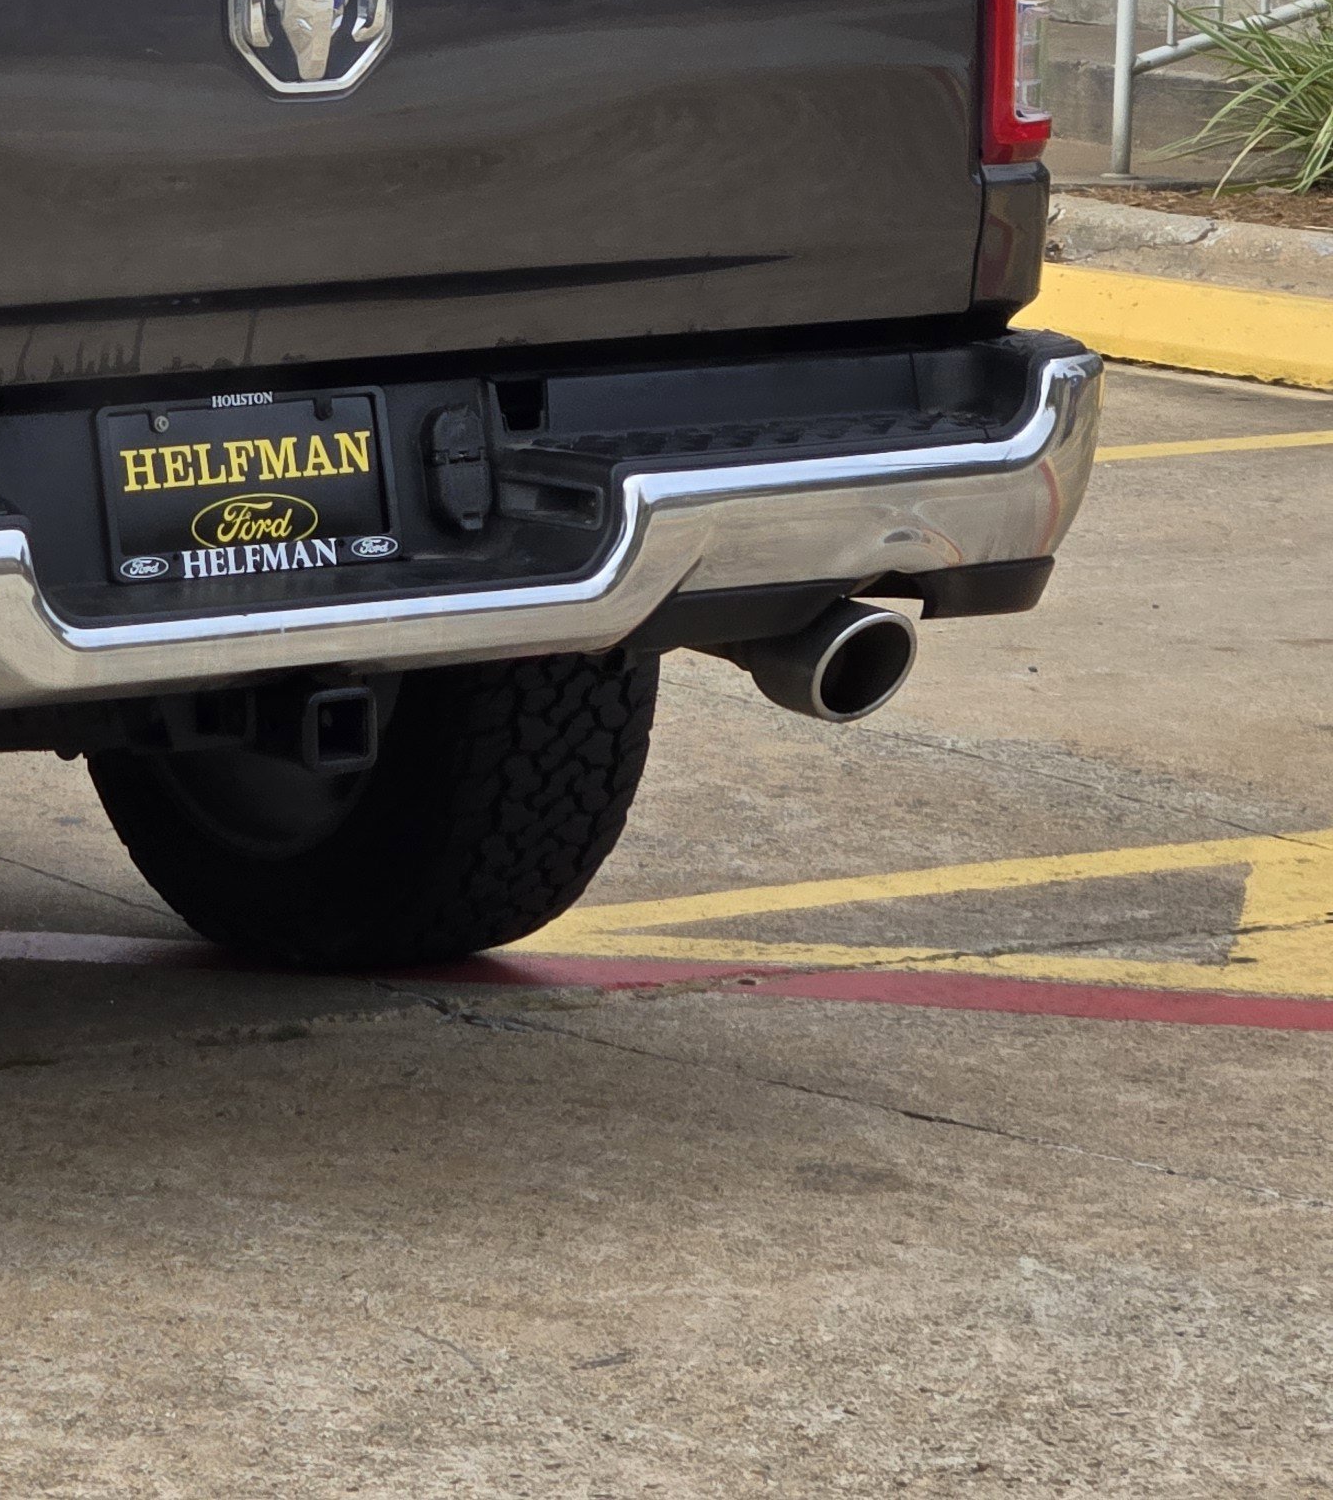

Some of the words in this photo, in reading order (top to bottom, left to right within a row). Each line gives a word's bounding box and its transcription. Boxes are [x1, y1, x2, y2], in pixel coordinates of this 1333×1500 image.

[211, 390, 274, 409] HOUSTON
[120, 431, 371, 492] HELFMAN
[217, 501, 293, 543] Ford
[181, 537, 338, 579] HELFMAN
